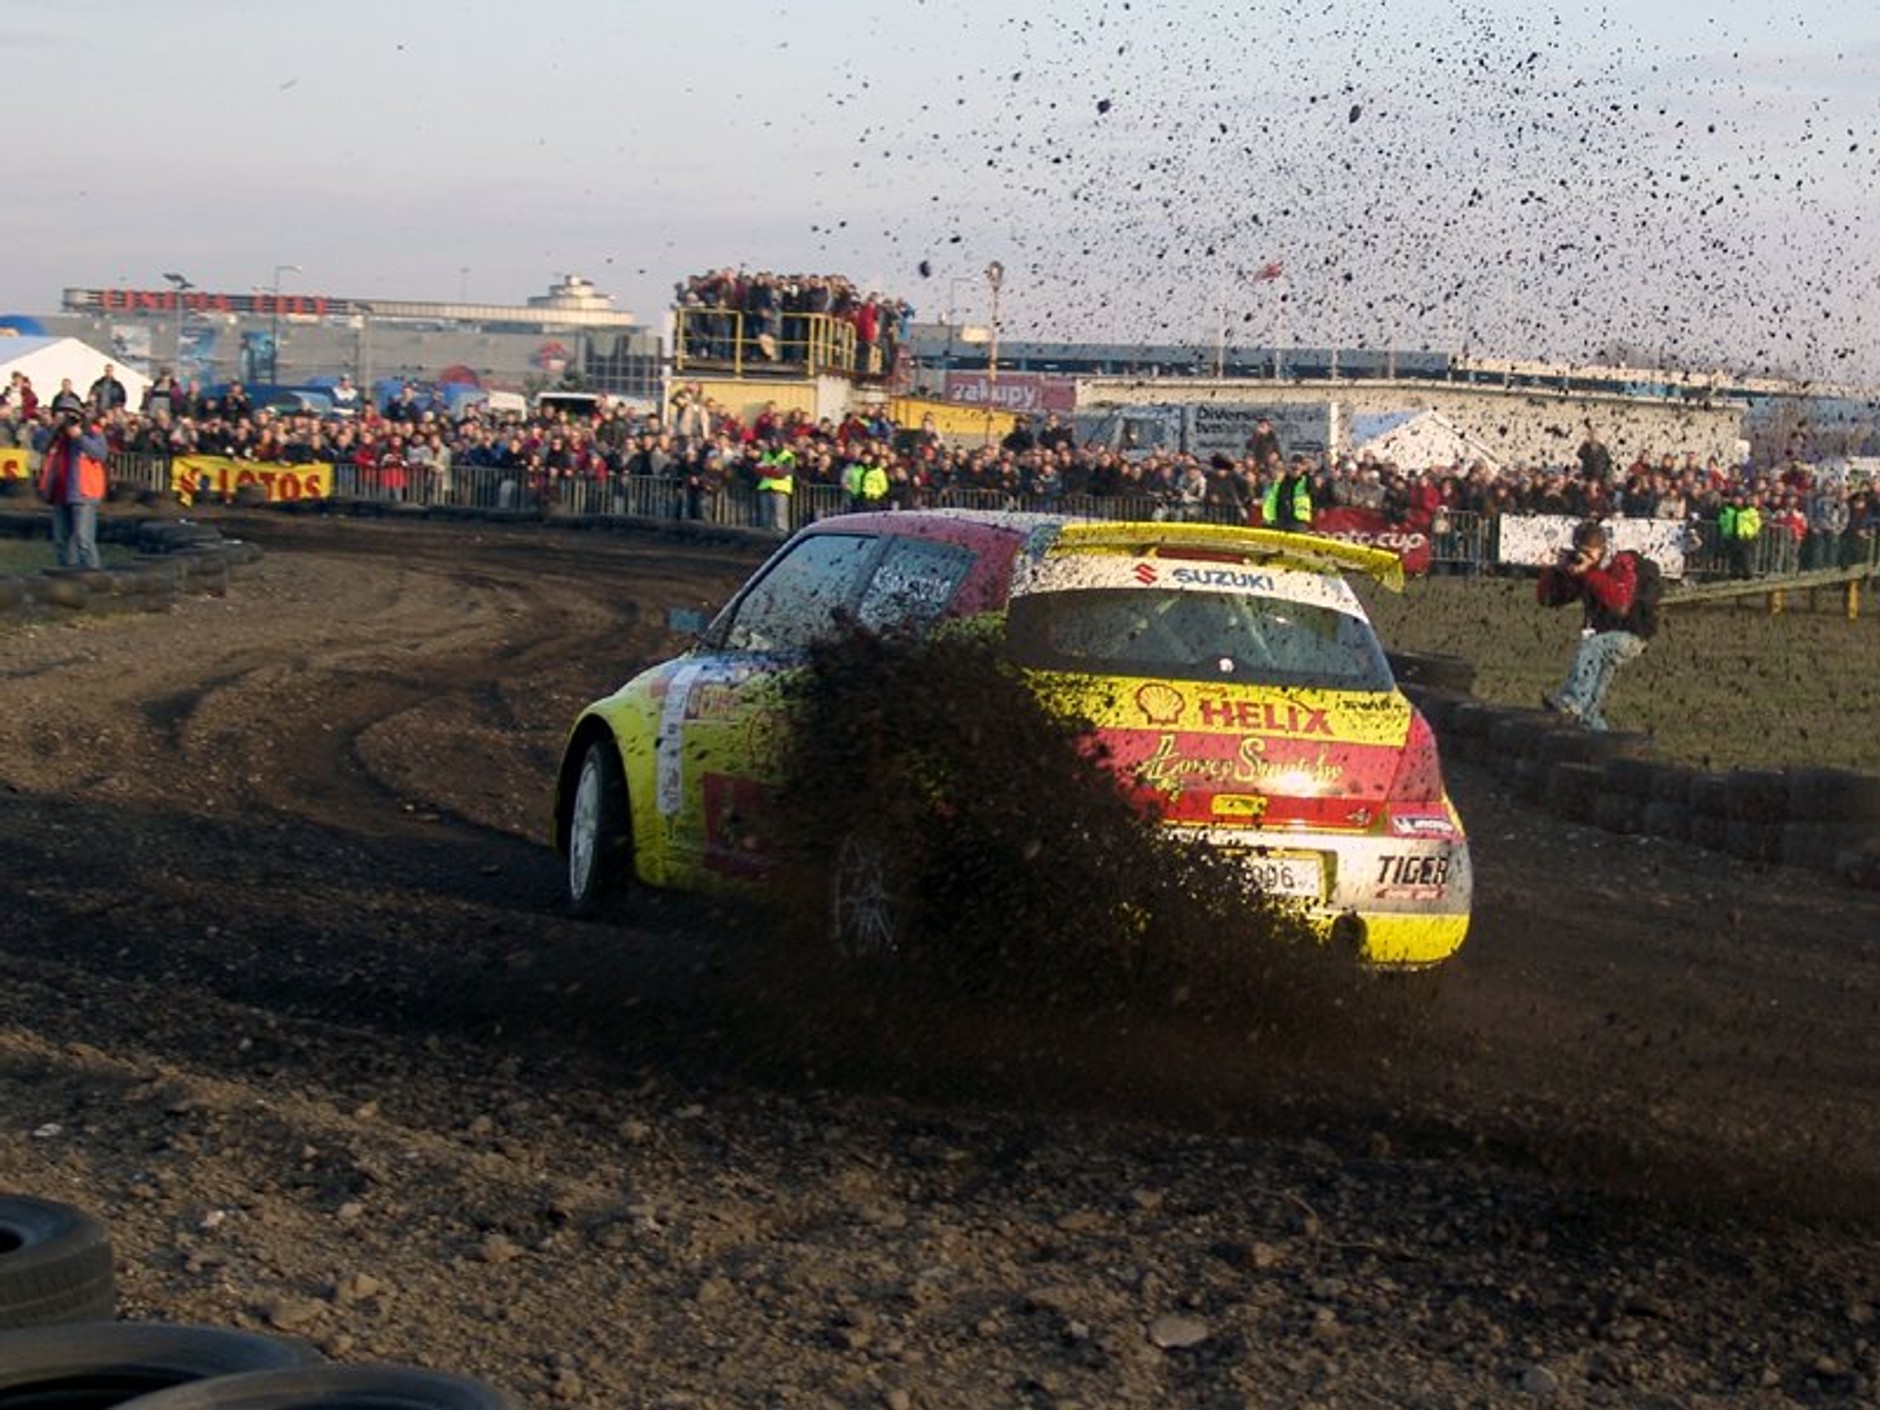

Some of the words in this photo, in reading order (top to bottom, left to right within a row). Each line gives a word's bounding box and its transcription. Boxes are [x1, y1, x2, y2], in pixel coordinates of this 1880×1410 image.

[102, 289, 228, 314] CINEMA
[253, 294, 330, 316] CITY
[1376, 532, 1426, 553] cup
[1172, 568, 1275, 591] SUZUKI
[1200, 699, 1334, 736] HELIX
[1377, 855, 1450, 885] TIGER
